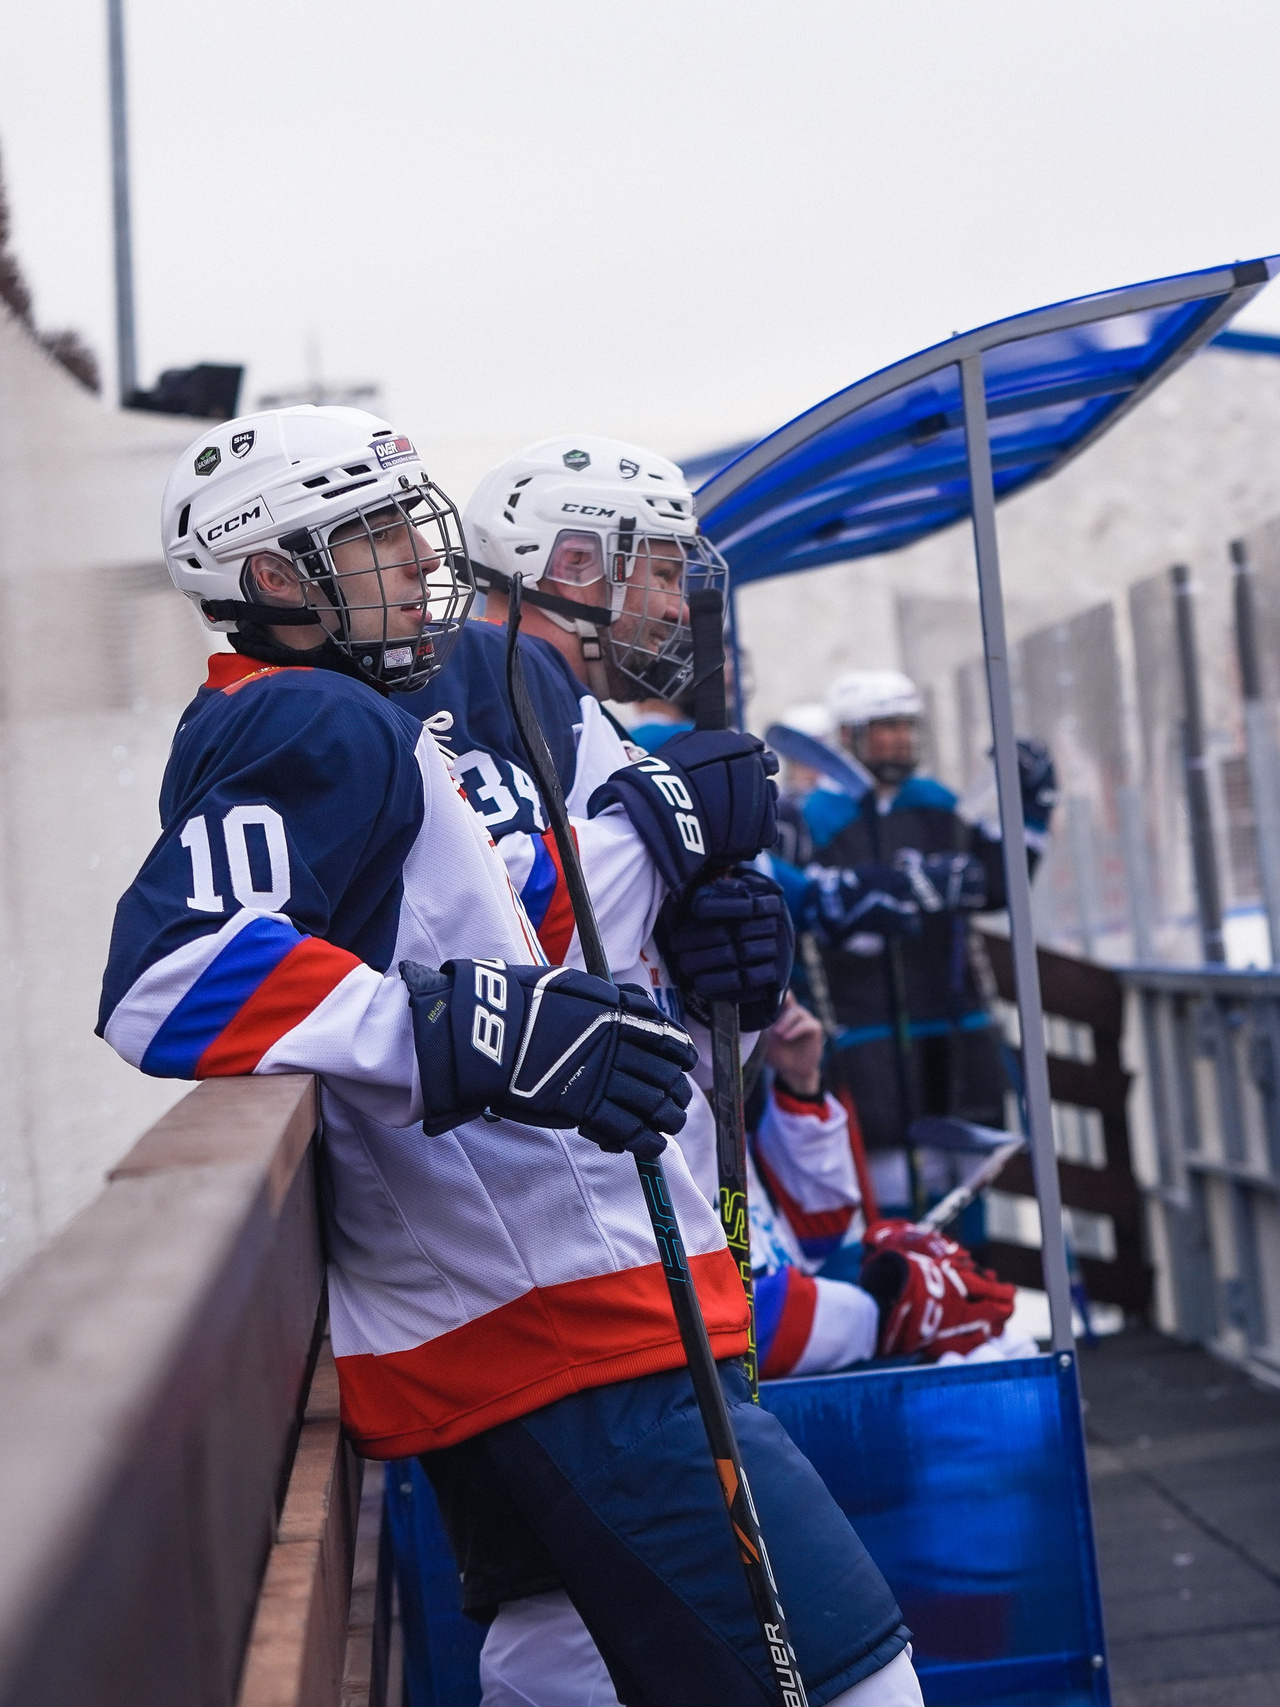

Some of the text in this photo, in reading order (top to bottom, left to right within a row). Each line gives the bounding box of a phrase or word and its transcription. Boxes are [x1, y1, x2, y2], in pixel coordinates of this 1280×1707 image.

[233, 433, 252, 444] SHL
[207, 505, 261, 541] CCM
[561, 502, 616, 518] CCM
[179, 804, 292, 913] 10
